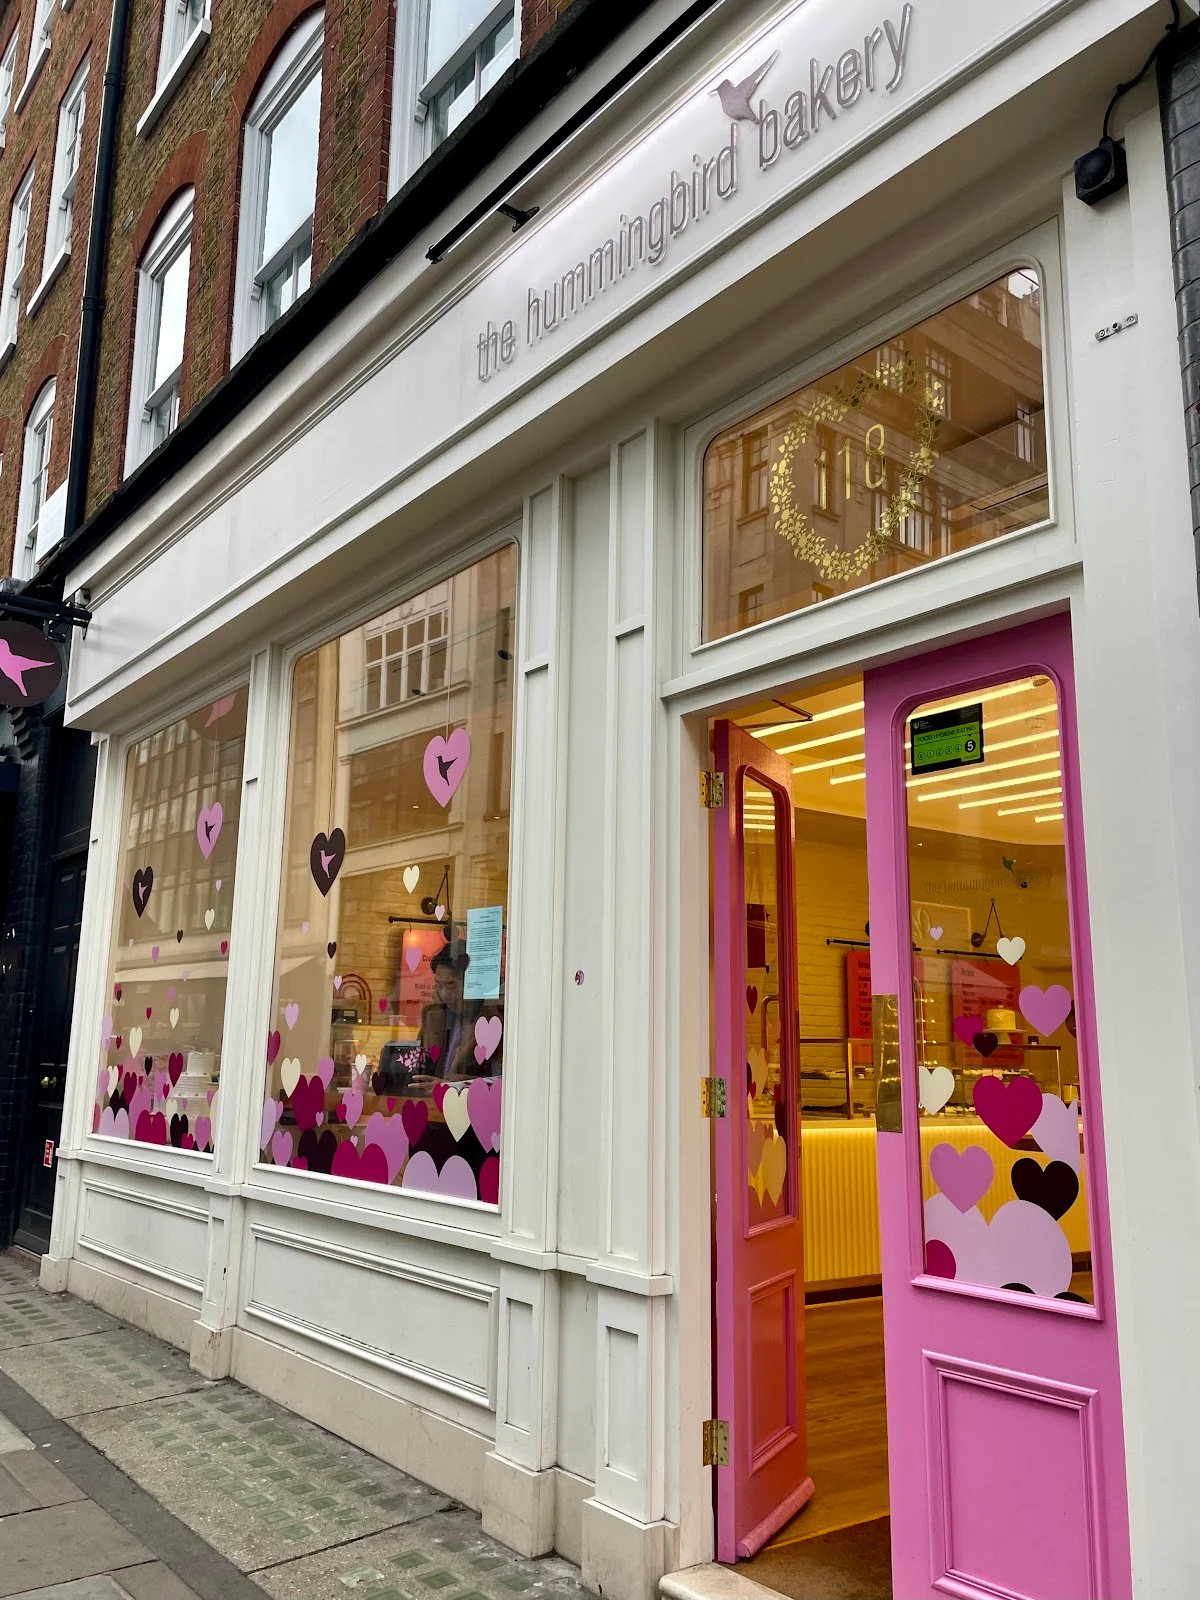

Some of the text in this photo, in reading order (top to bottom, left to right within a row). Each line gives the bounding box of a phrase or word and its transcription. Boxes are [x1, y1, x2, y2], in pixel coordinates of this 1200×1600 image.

[477, 2, 912, 383] the hummingbird bakery
[814, 423, 887, 511] 118
[934, 730, 955, 739] HYGIENE
[957, 725, 976, 733] RATING
